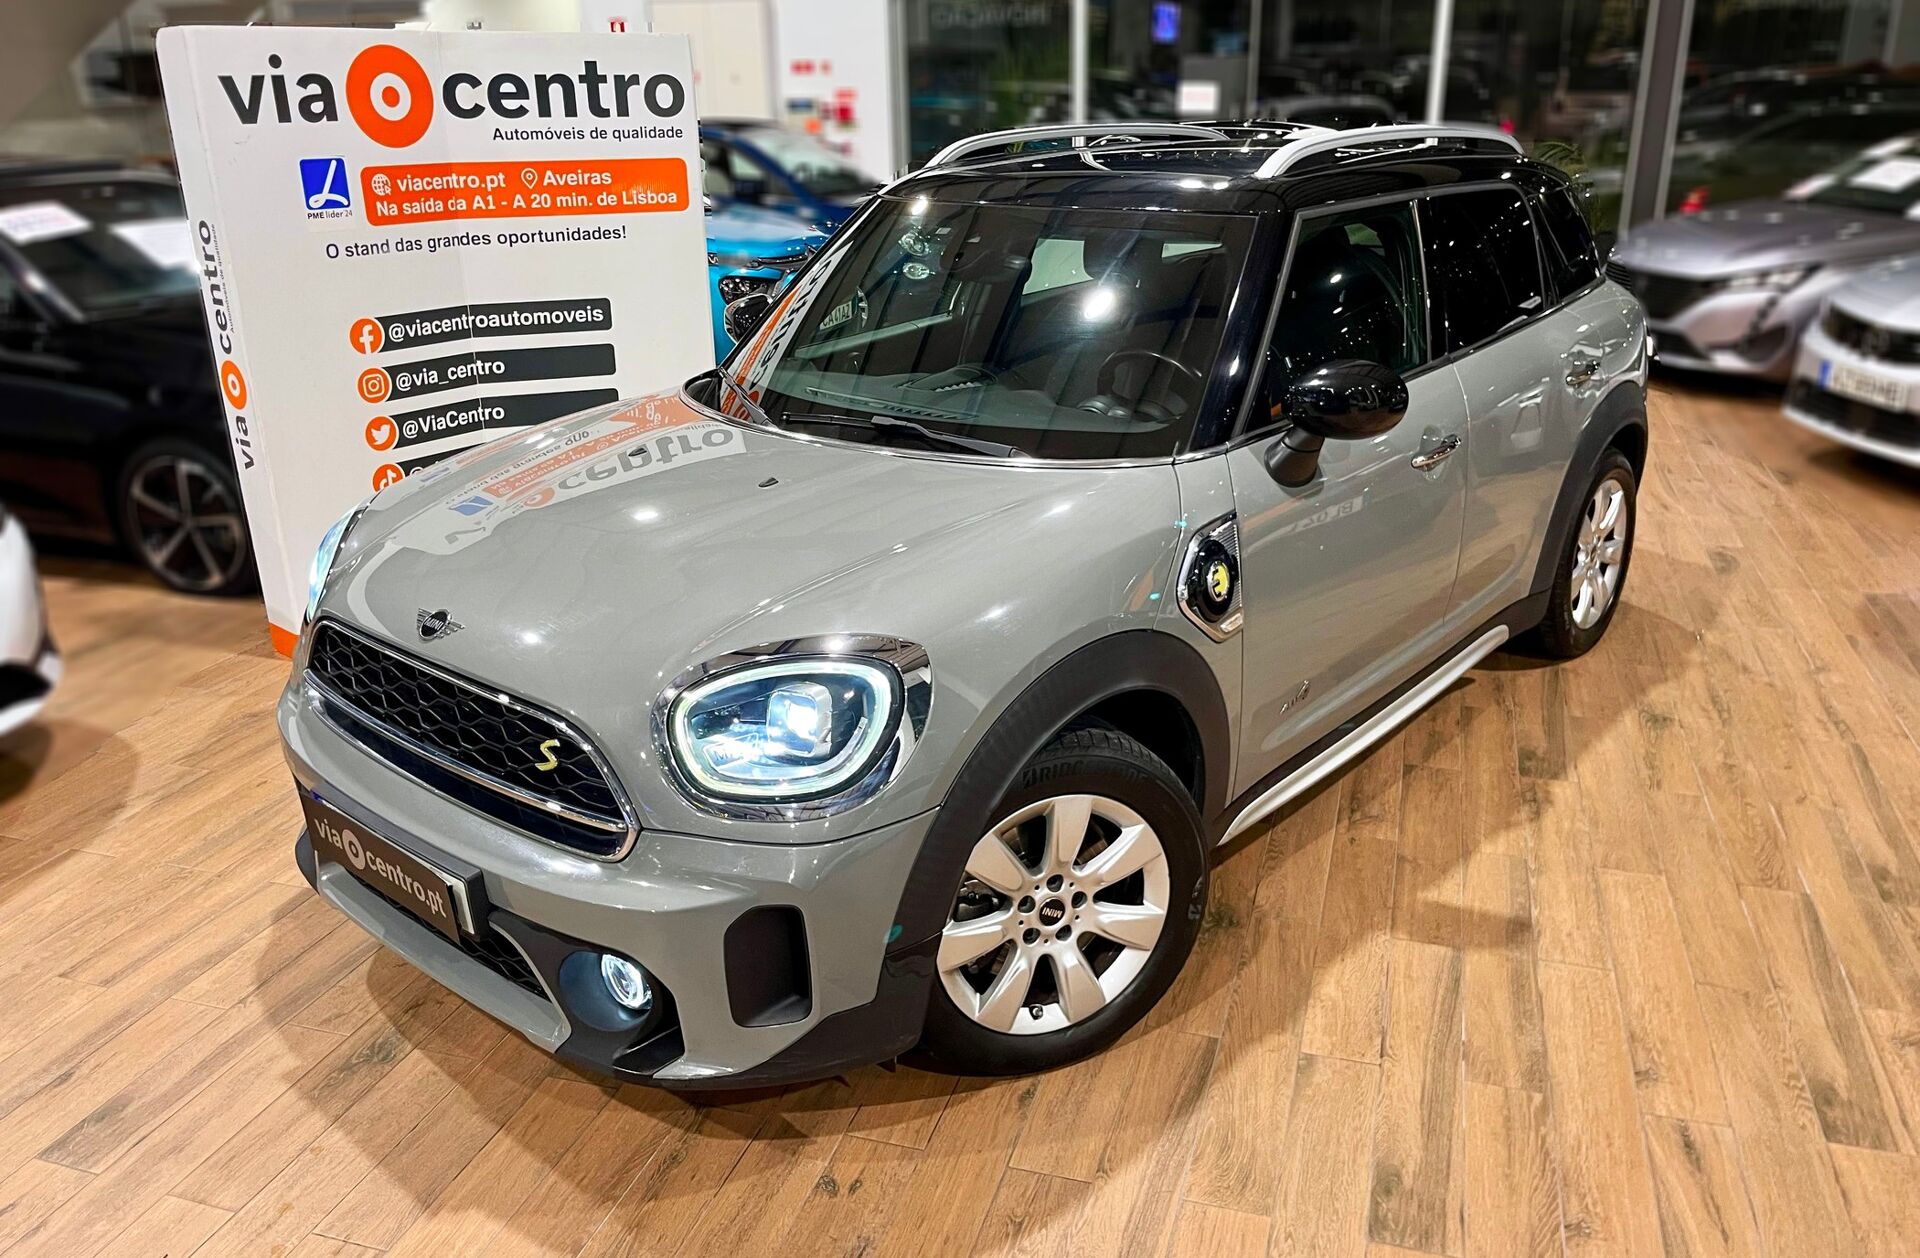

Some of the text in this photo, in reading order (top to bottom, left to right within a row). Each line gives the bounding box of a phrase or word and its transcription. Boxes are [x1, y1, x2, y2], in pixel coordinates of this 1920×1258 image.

[218, 53, 686, 125] via centro
[493, 124, 684, 142] Automóveis de qualidade
[396, 171, 506, 192] viacentro.pt
[543, 169, 612, 187] Aveiras
[307, 212, 325, 220] PME
[375, 200, 399, 217] Na
[402, 196, 445, 215] saída
[447, 196, 467, 210] da
[472, 194, 496, 210] A1
[512, 193, 526, 209] A
[530, 193, 551, 209] 20
[556, 192, 593, 208] min.
[596, 191, 617, 206] de
[622, 190, 677, 205] Lisboa
[325, 225, 627, 259] O stand das grandes oportunidades!
[388, 305, 604, 342] @viacentroautomoveis
[198, 219, 256, 470] via centro
[396, 359, 506, 391] @via_centro
[402, 405, 505, 439] @ViaCentro
[423, 617, 444, 631] MINI
[534, 738, 560, 771] S
[314, 818, 447, 919] via centro.pt
[1041, 906, 1063, 919] MINI
